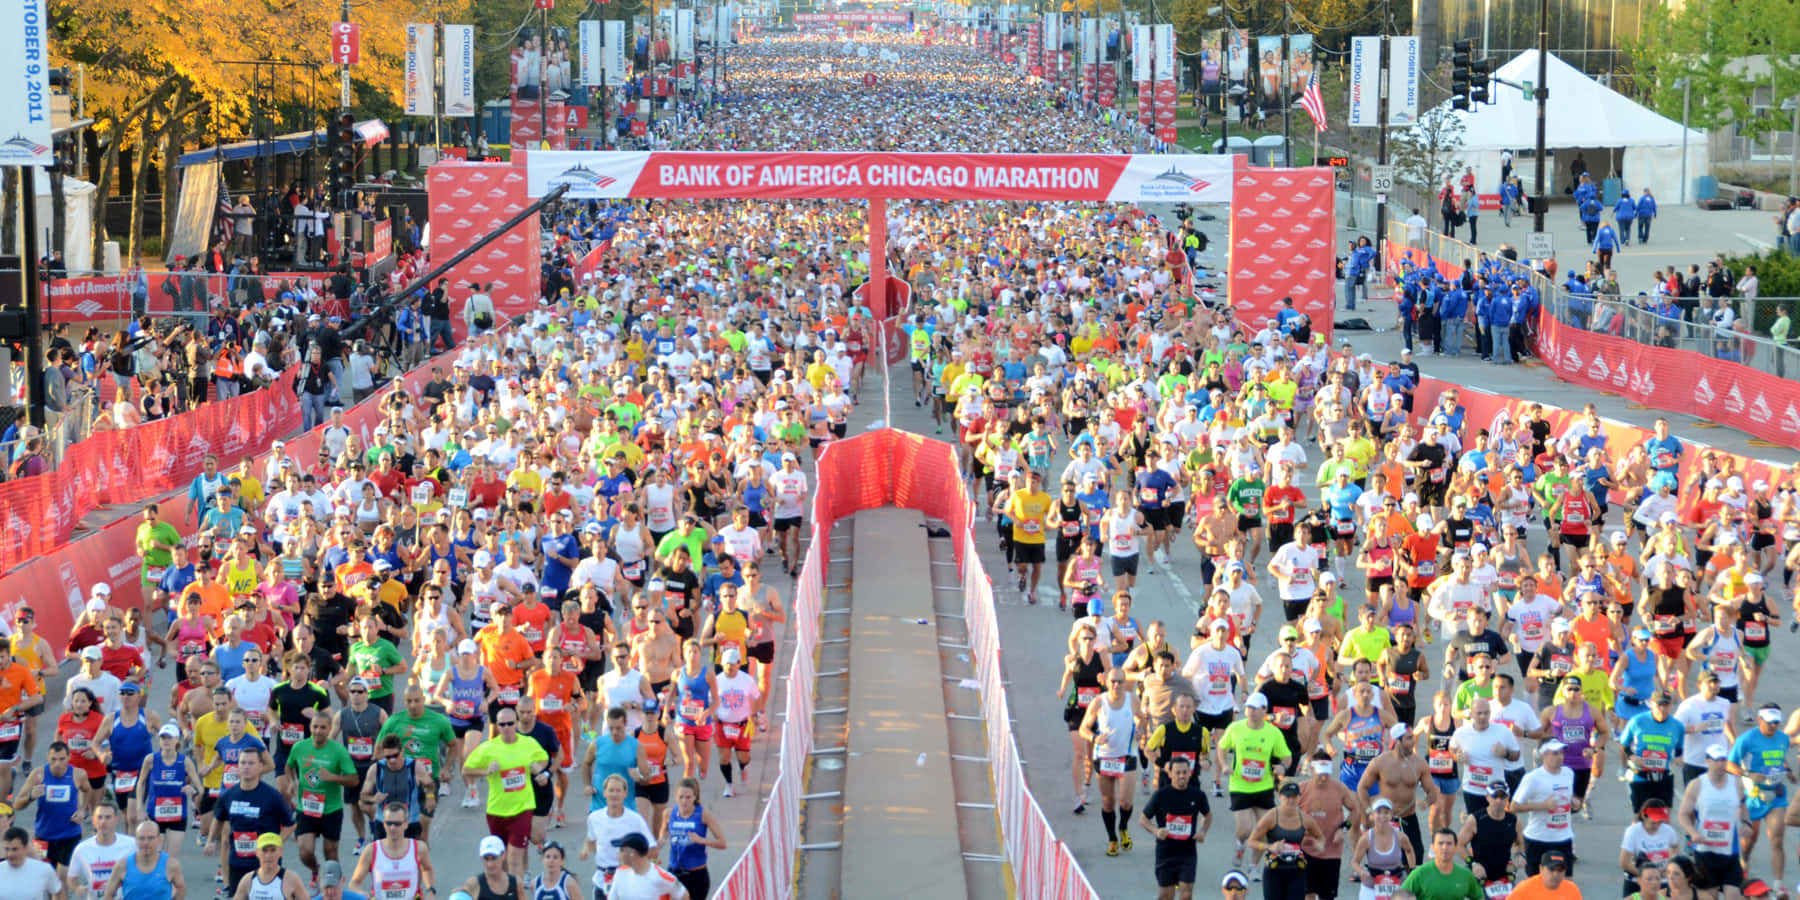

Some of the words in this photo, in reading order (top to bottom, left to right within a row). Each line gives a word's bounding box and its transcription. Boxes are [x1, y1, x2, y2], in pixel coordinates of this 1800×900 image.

[24, 0, 40, 61] TOBER
[27, 81, 44, 124] 2011
[567, 108, 579, 122] A
[660, 165, 720, 186] BANK
[726, 165, 755, 186] OF
[759, 165, 862, 187] AMERICA
[867, 165, 969, 187] CHICAGO
[974, 167, 1099, 188] MARATHON
[1375, 179, 1390, 189] 30
[74, 281, 85, 294] of
[234, 579, 252, 593] NF
